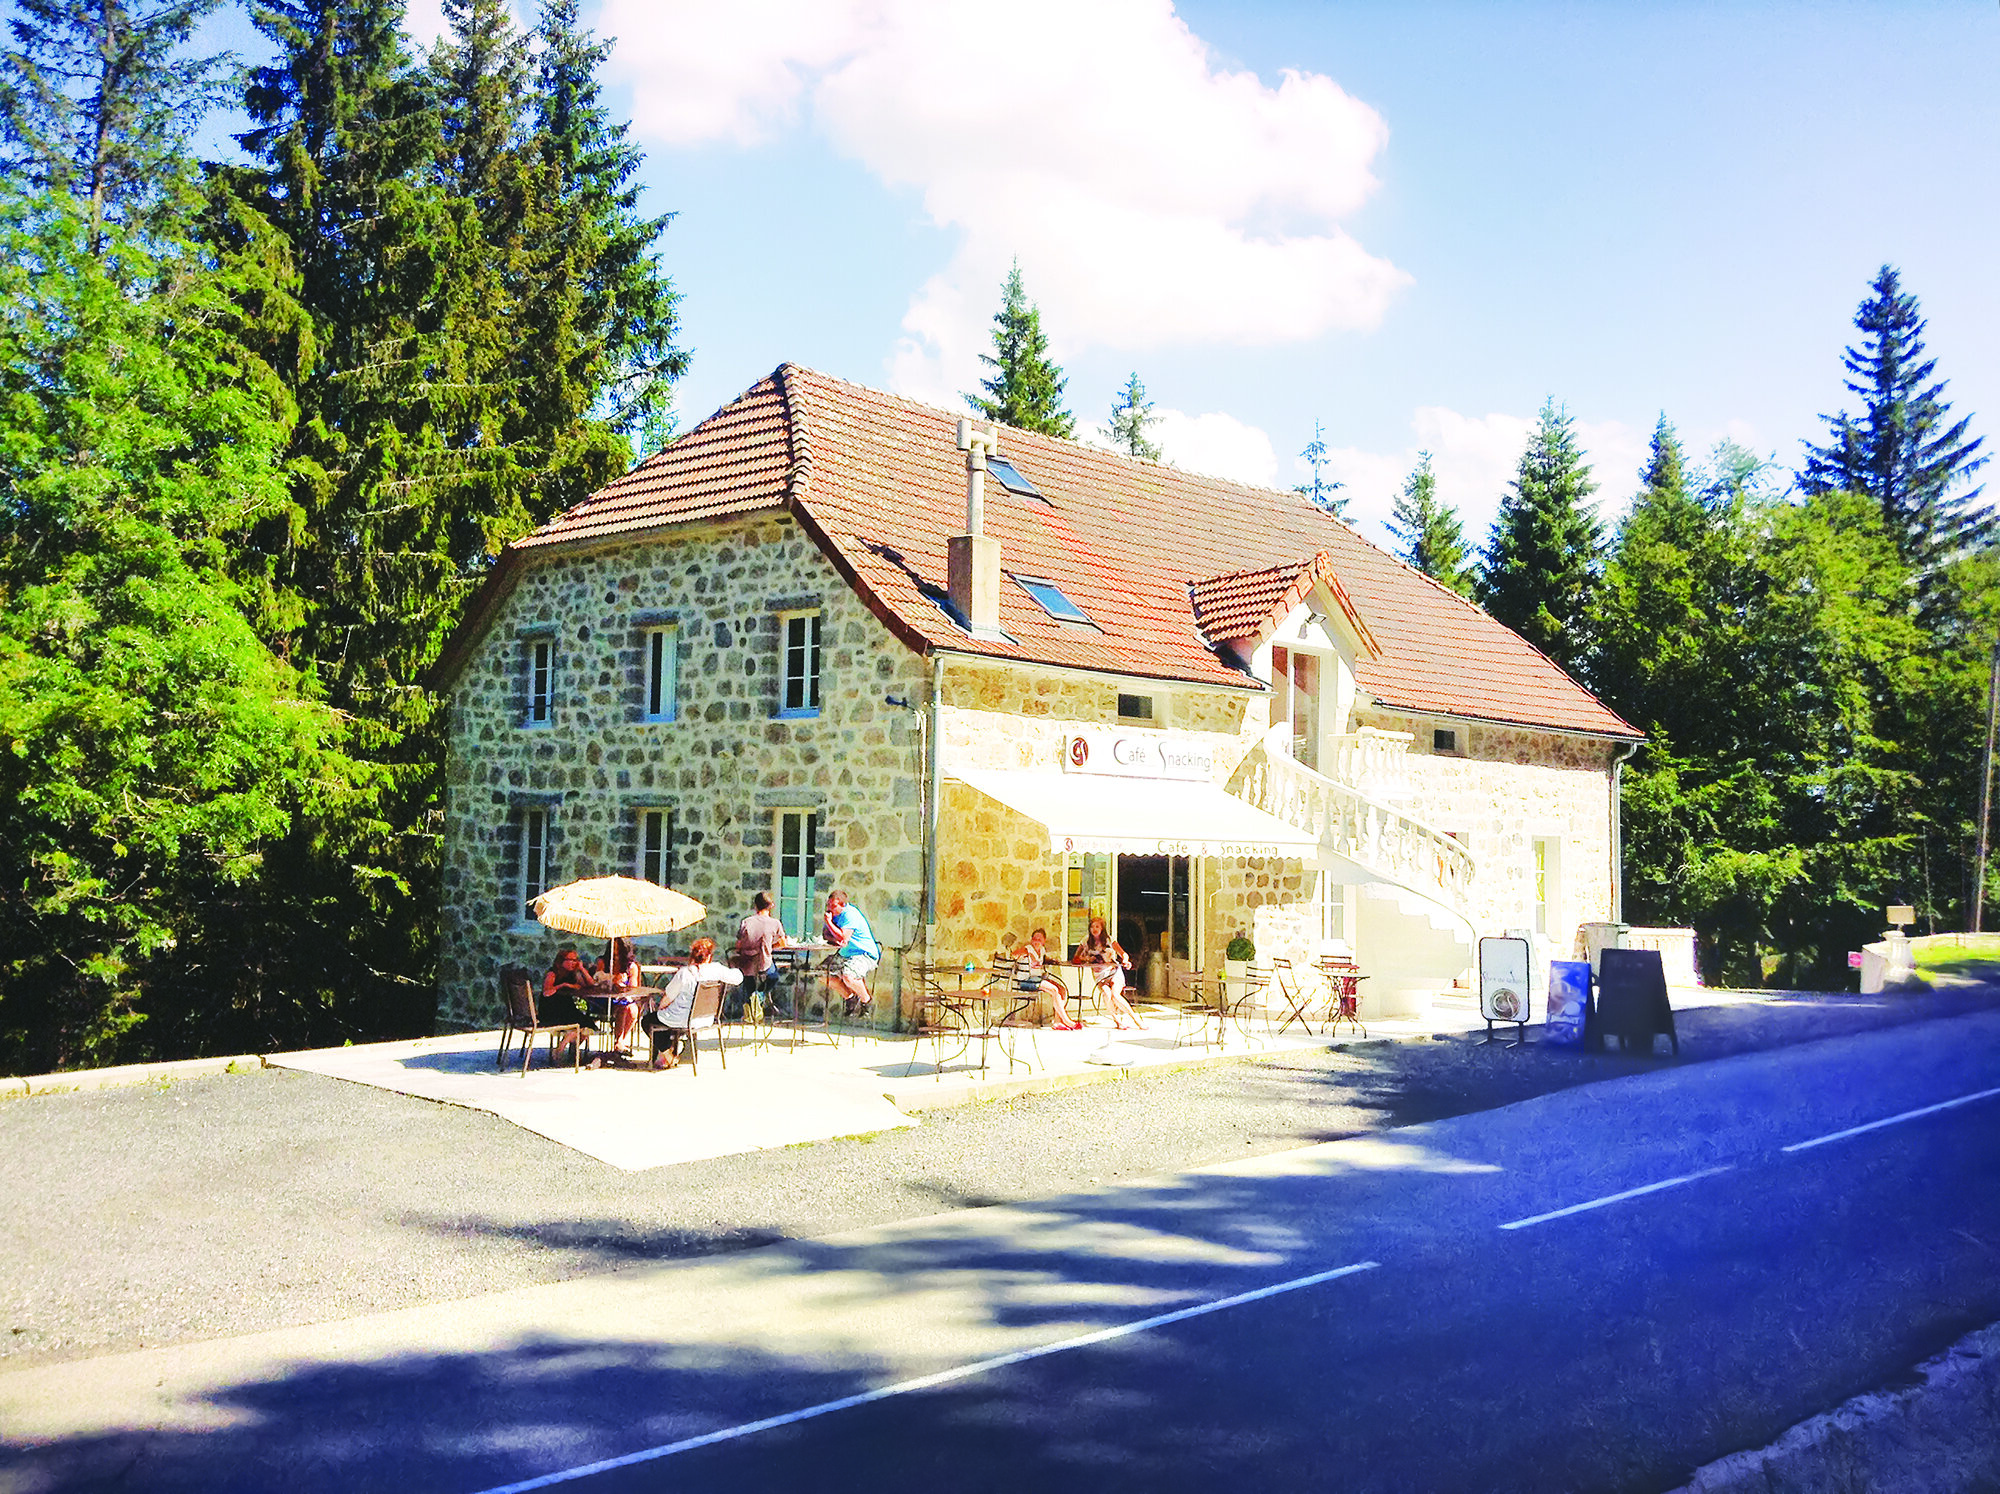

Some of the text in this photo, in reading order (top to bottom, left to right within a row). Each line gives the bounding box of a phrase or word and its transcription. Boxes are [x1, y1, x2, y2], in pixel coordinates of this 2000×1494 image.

[1113, 739, 1146, 766] Café
[1158, 741, 1211, 772] Snacking
[1201, 842, 1208, 855] &
[1220, 840, 1278, 858] Snacking
